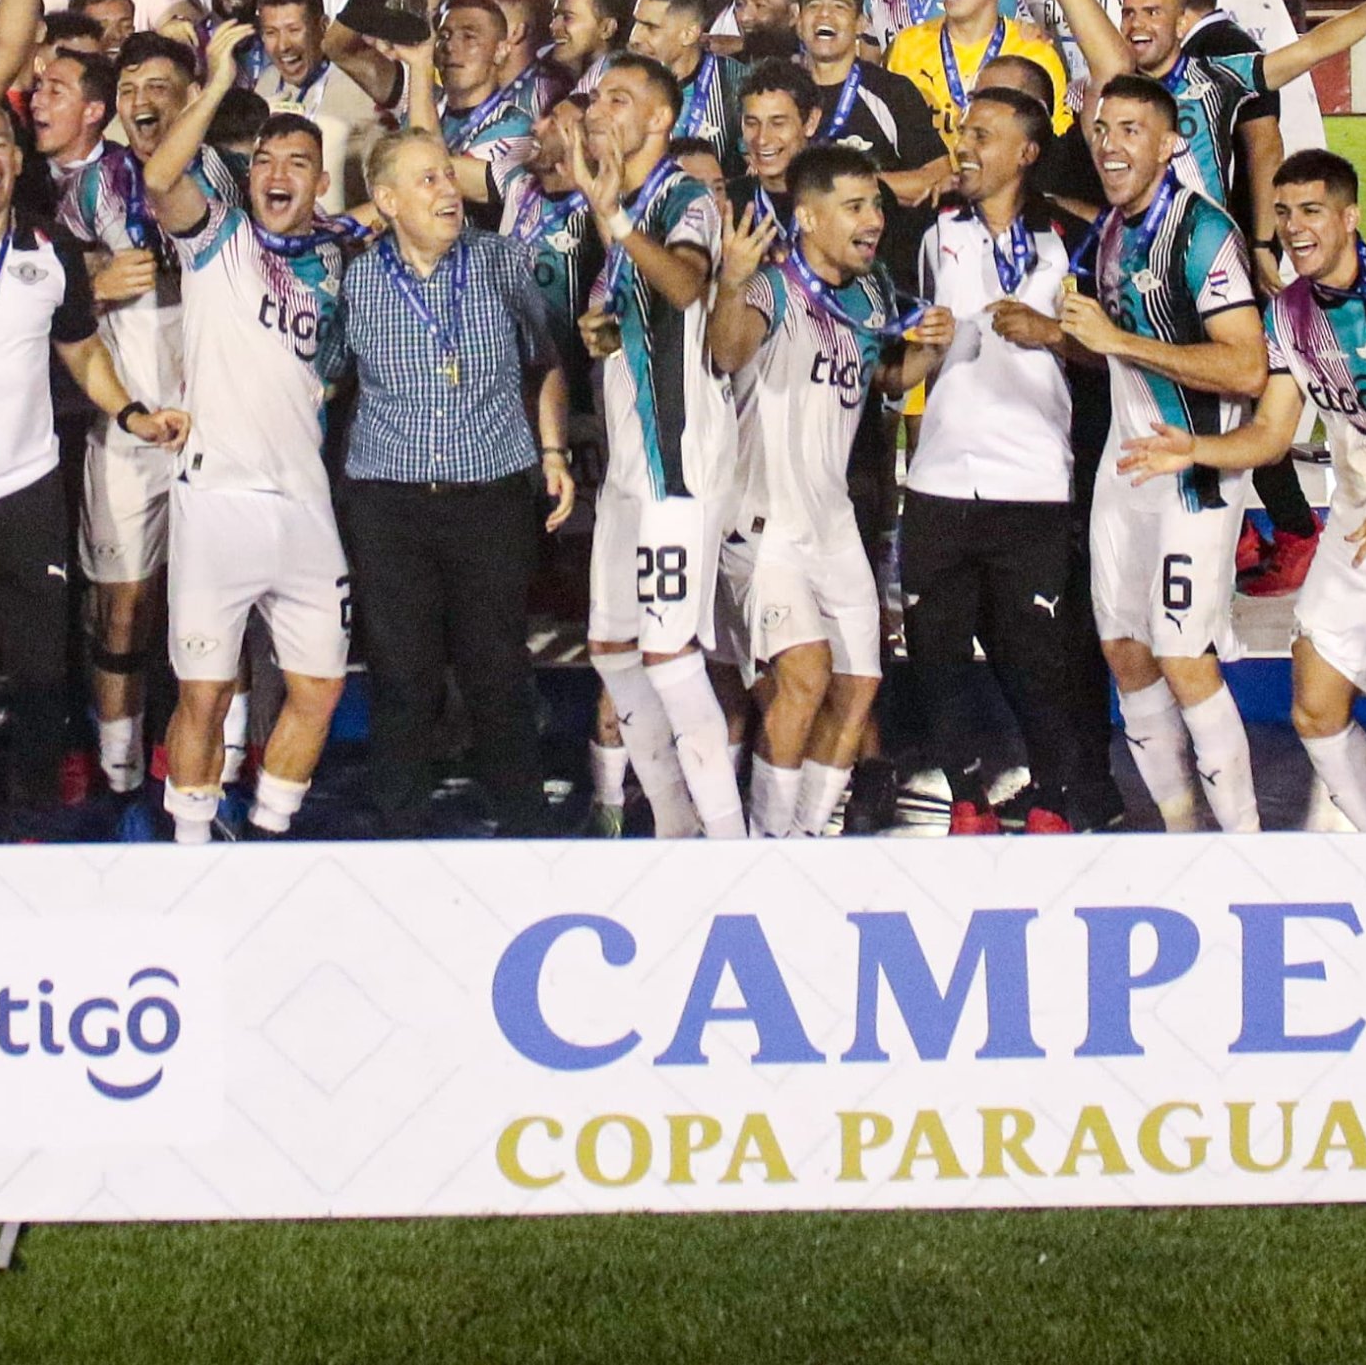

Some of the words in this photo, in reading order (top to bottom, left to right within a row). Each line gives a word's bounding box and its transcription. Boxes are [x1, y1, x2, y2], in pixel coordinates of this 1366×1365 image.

[636, 545, 687, 603] 28
[1162, 553, 1193, 611] 6
[495, 1110, 796, 1190] COPA
